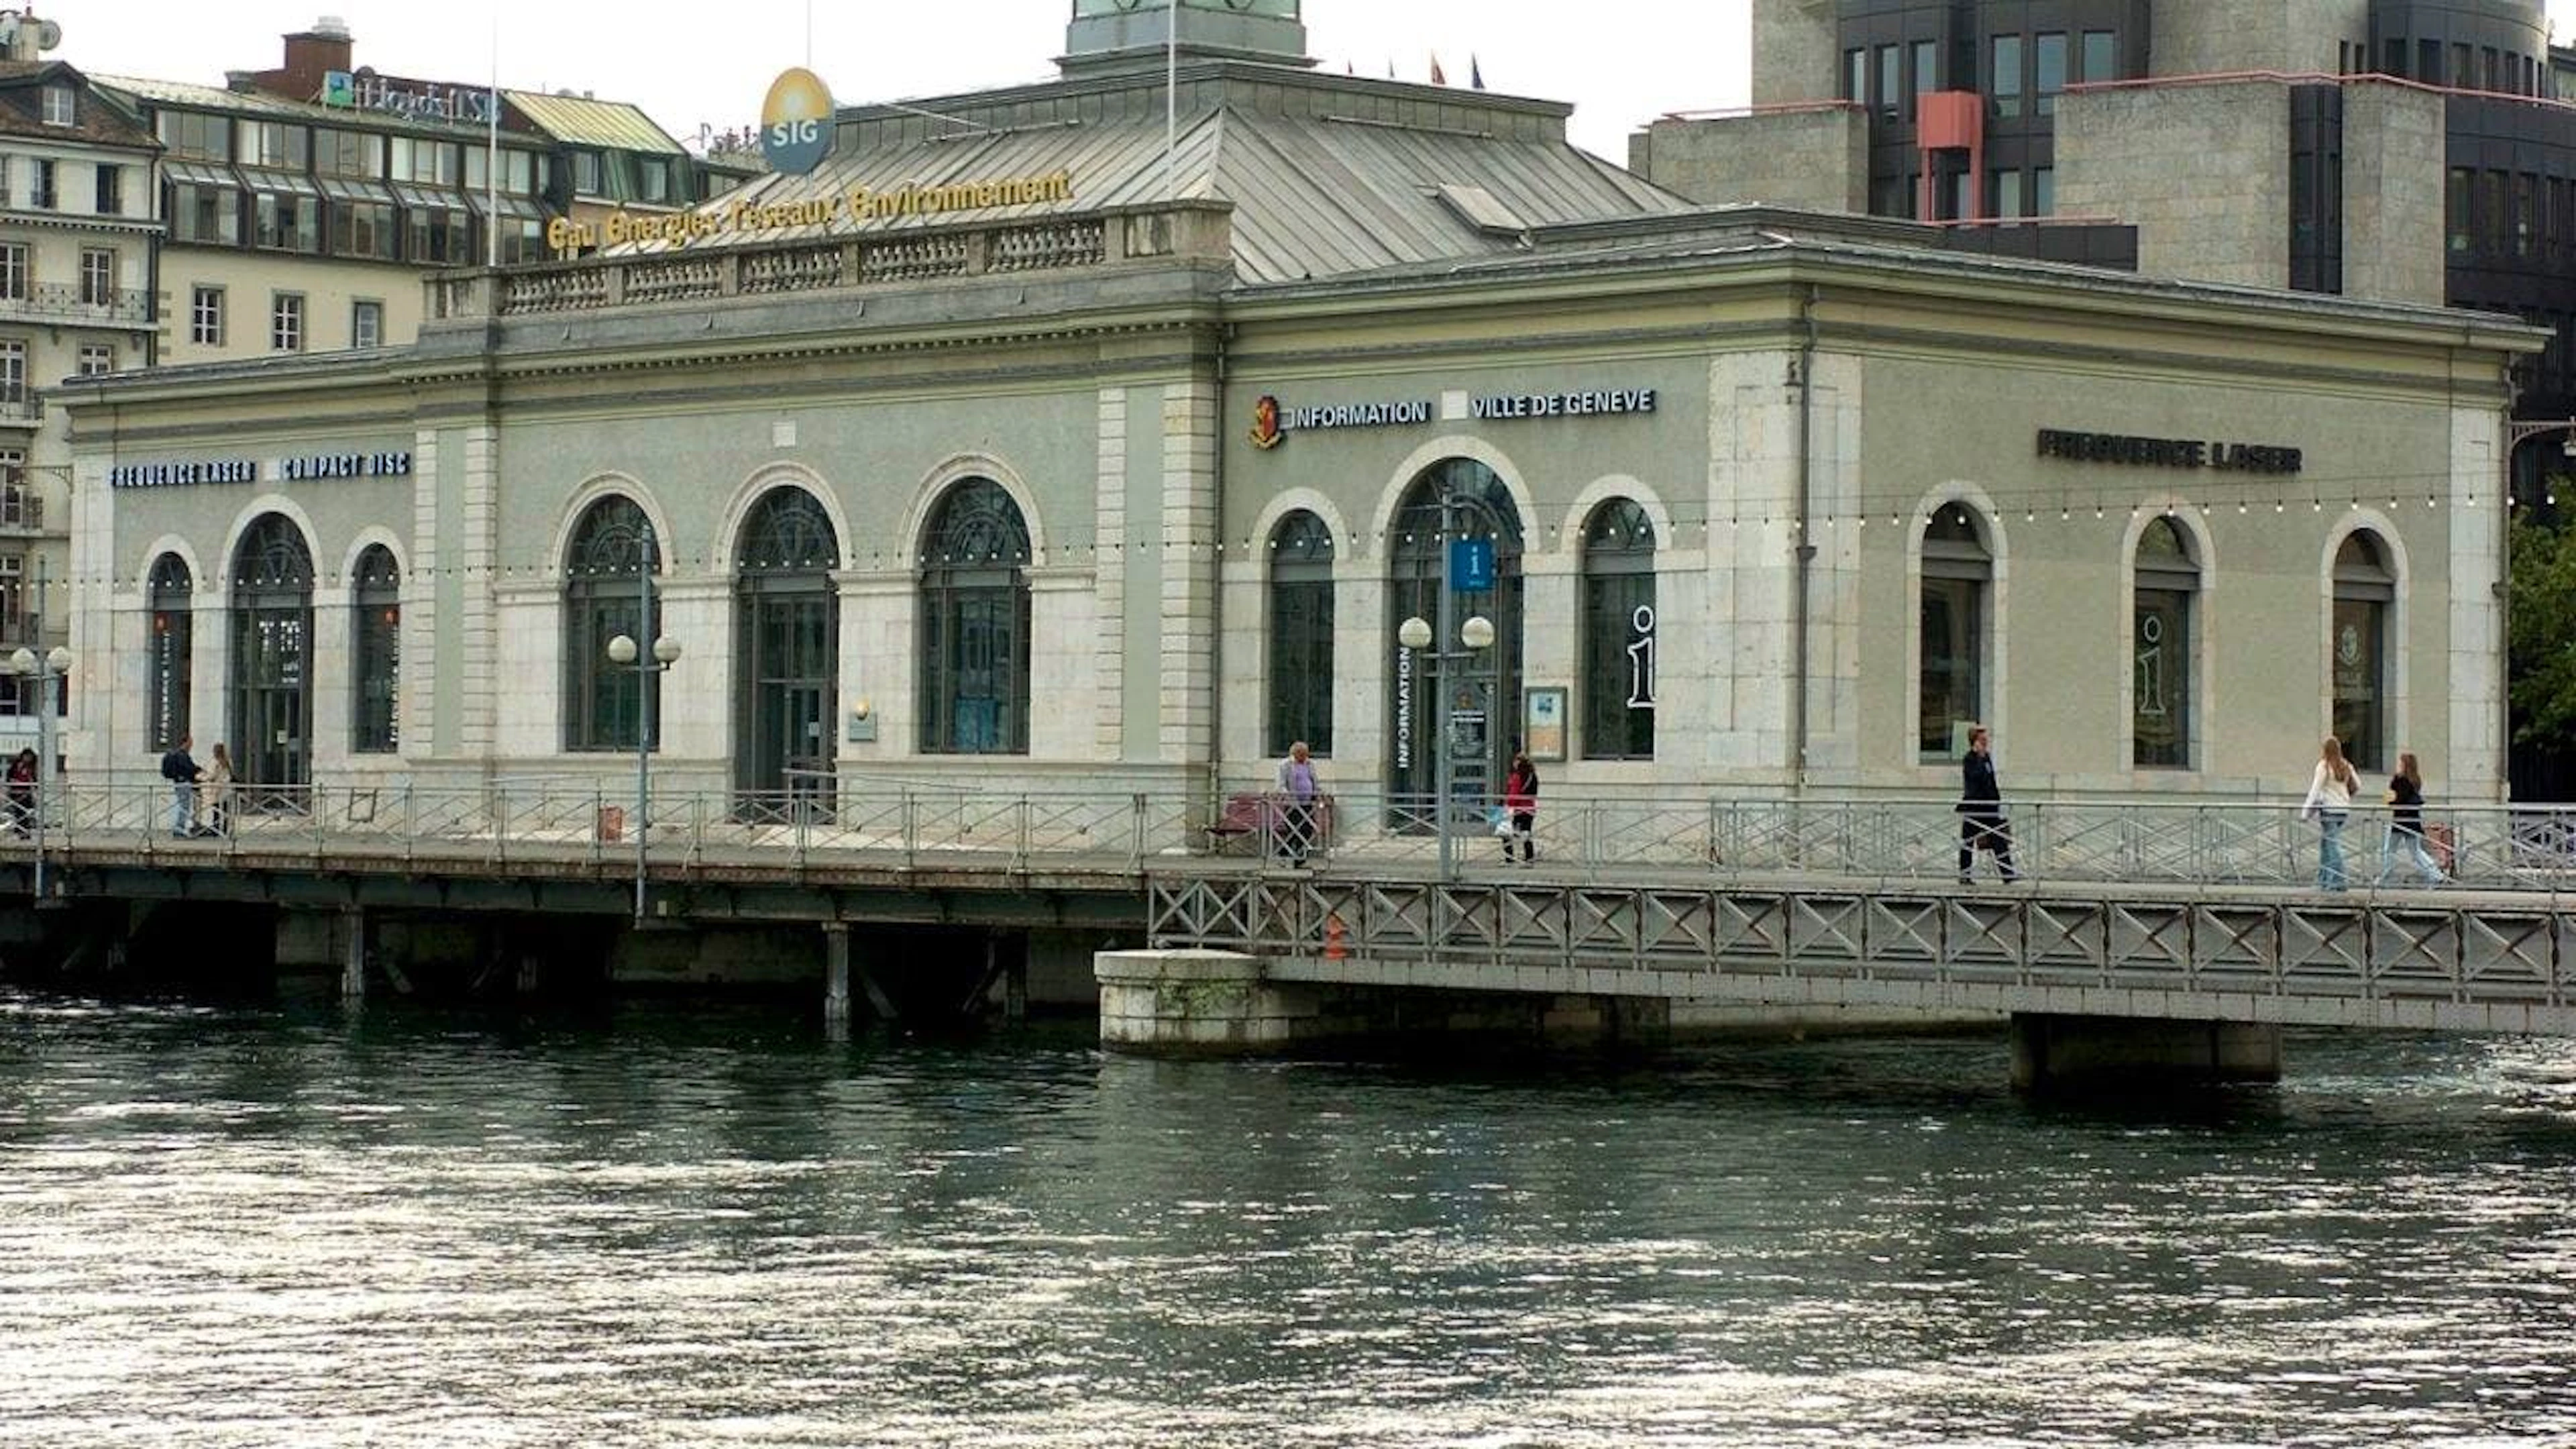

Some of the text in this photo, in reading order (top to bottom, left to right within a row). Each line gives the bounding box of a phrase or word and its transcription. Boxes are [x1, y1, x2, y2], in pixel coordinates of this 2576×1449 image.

[773, 119, 818, 148] SIG
[1291, 402, 1430, 430] INFORMATION
[1471, 388, 1654, 419] VILLE DE GENEVE
[282, 451, 411, 480] COMPACT DISC
[1397, 647, 1409, 769] INFORMATION
